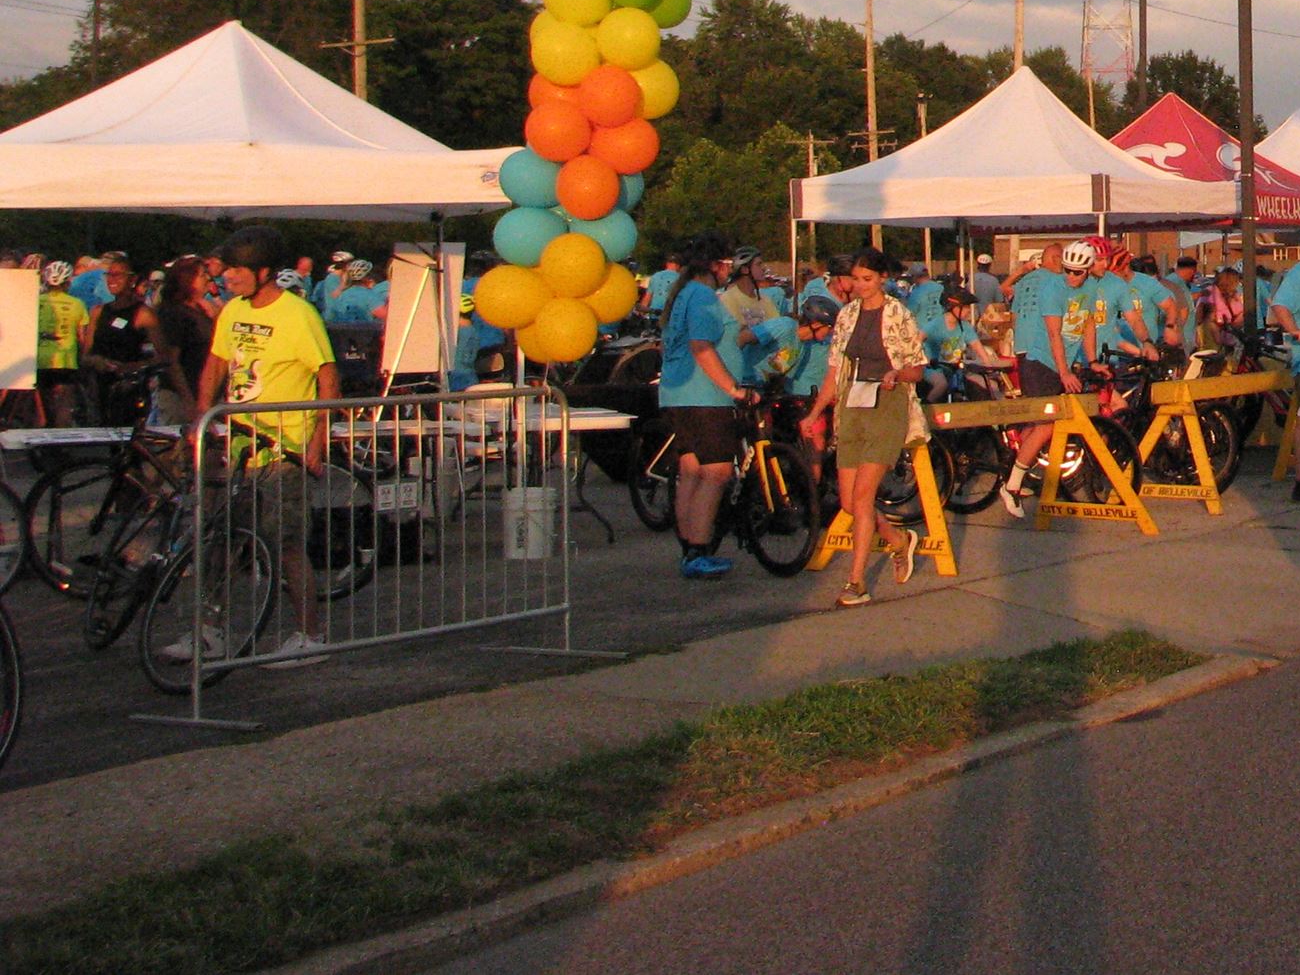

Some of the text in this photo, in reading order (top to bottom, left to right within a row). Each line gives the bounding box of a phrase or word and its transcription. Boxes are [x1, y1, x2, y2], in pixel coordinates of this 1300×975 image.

[1142, 485, 1212, 498] OF BELLEVILLE
[1041, 504, 1137, 519] CITY OF BELLEVILLE
[827, 534, 853, 546] CITY
